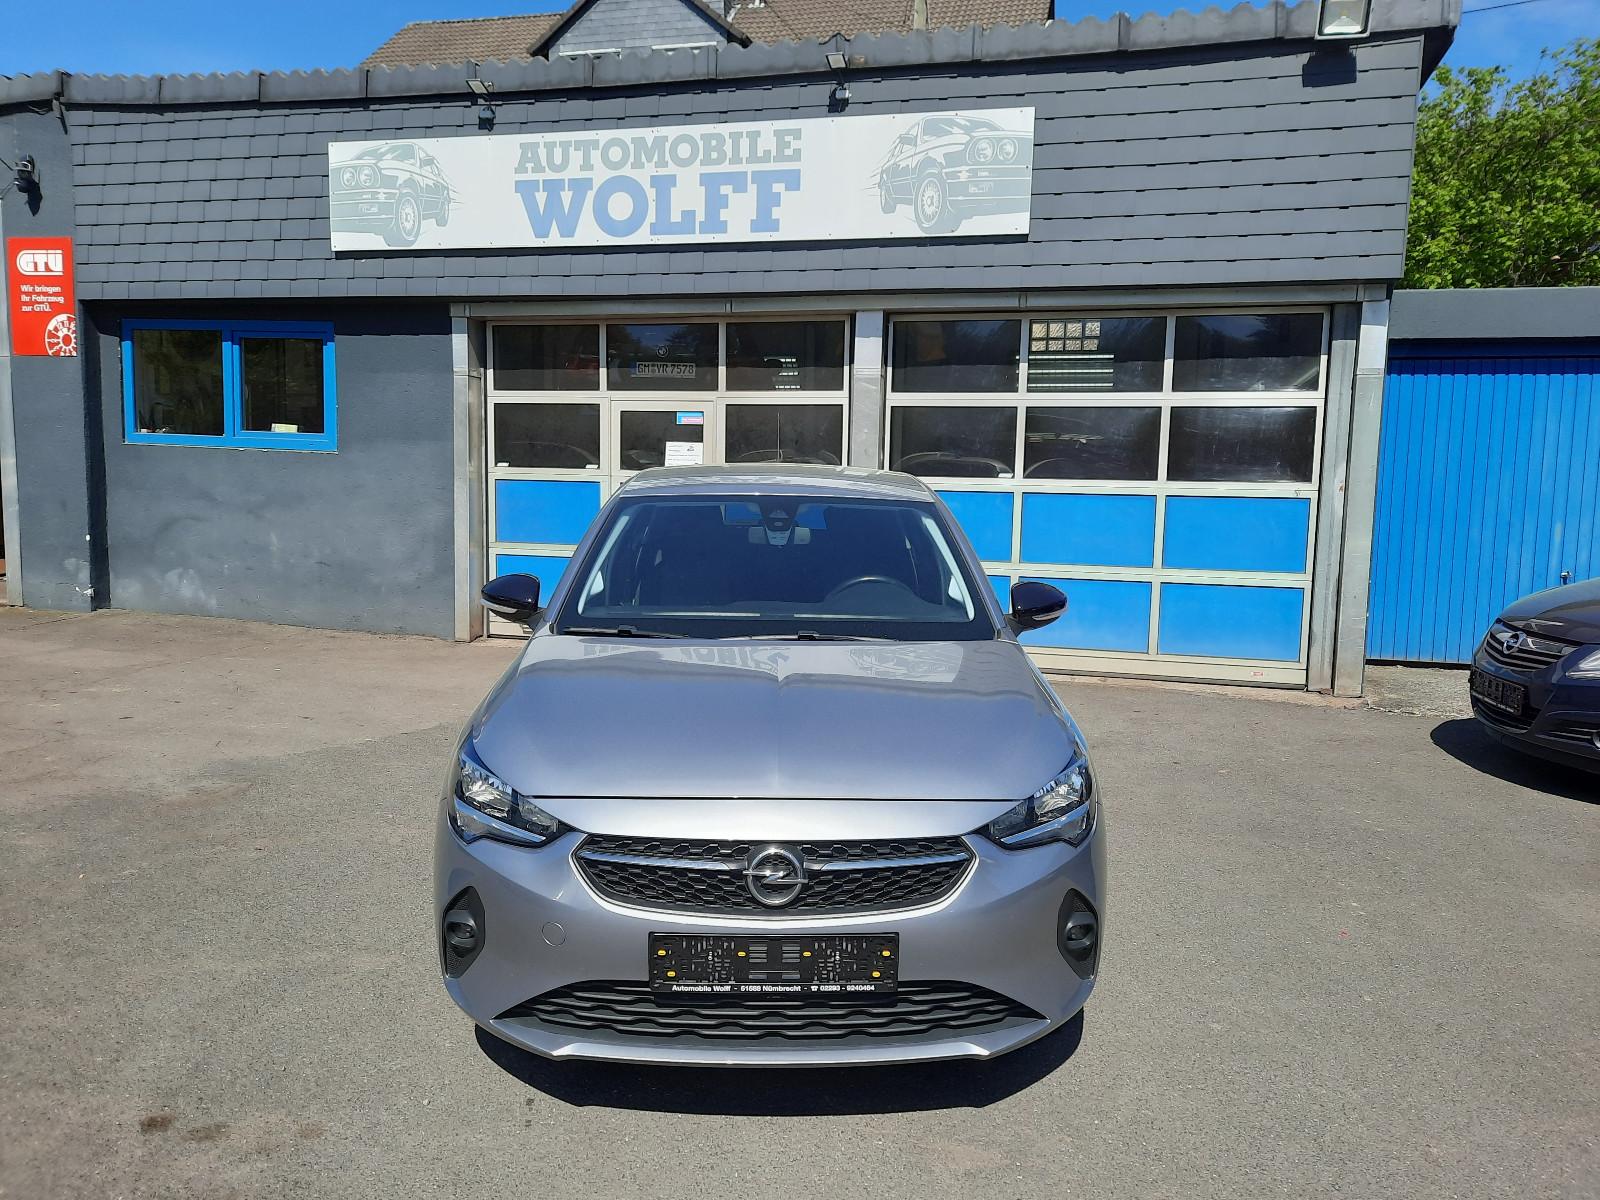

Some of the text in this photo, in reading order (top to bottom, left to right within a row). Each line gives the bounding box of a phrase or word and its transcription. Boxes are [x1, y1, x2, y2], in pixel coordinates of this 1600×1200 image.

[514, 128, 802, 174] AUTOMOBILE
[514, 169, 801, 238] WOLFF
[20, 284, 62, 294] Wir bringen
[32, 294, 64, 304] Fahrzeug
[34, 302, 52, 312] GTÜ.
[637, 363, 694, 375] GM VR 7578
